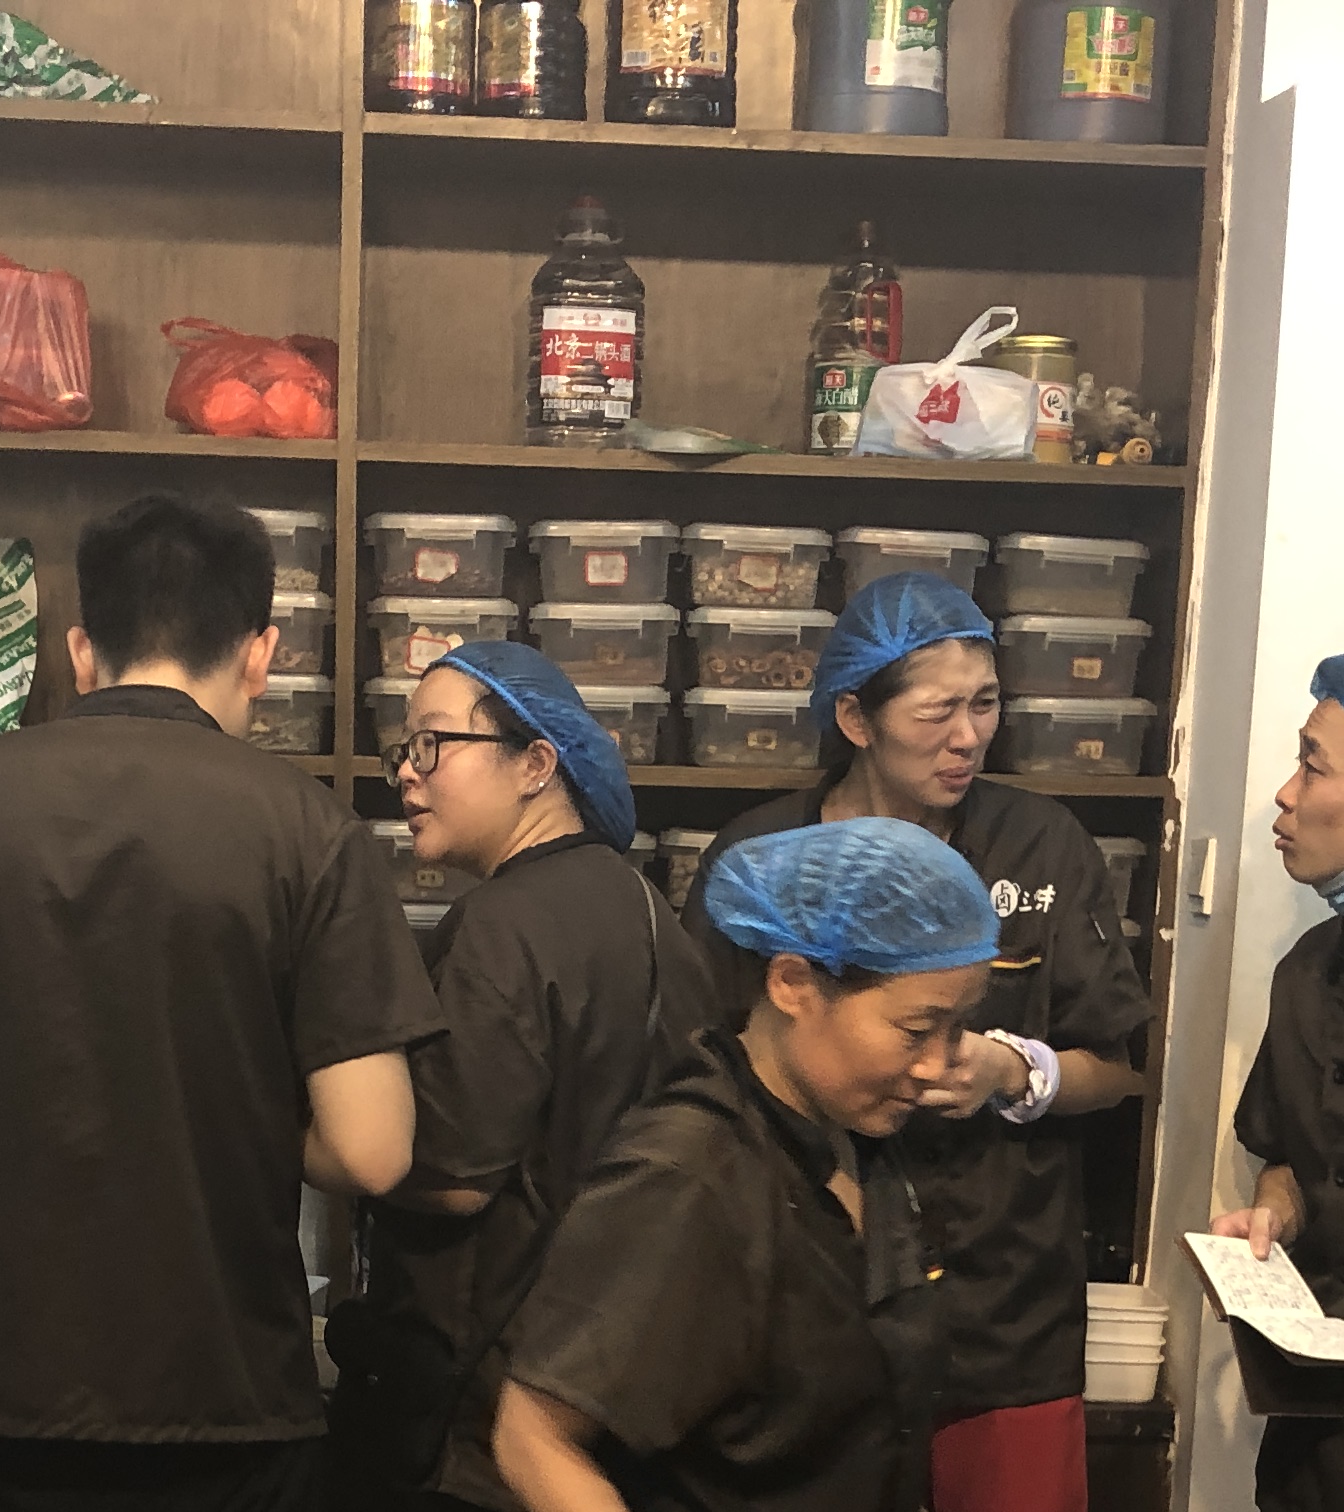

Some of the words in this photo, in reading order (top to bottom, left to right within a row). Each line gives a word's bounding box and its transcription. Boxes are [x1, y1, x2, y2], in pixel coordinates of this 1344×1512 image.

[545, 333, 631, 362] 北京二锅头酒
